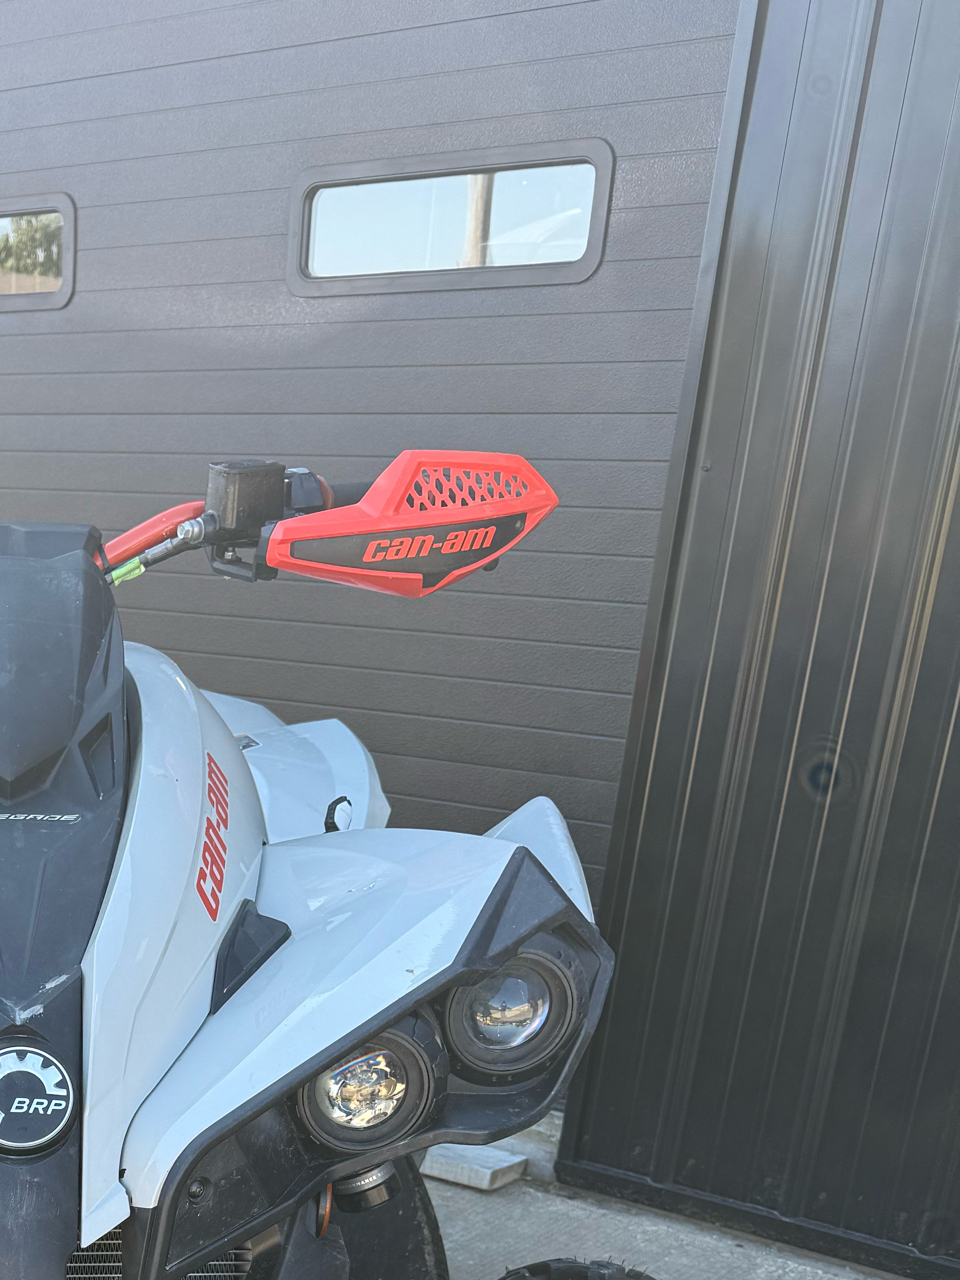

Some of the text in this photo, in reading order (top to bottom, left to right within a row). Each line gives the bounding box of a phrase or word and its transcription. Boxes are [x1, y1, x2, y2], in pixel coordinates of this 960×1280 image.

[362, 525, 496, 563] can-am
[196, 752, 230, 922] can-am
[10, 1097, 66, 1115] BRP
